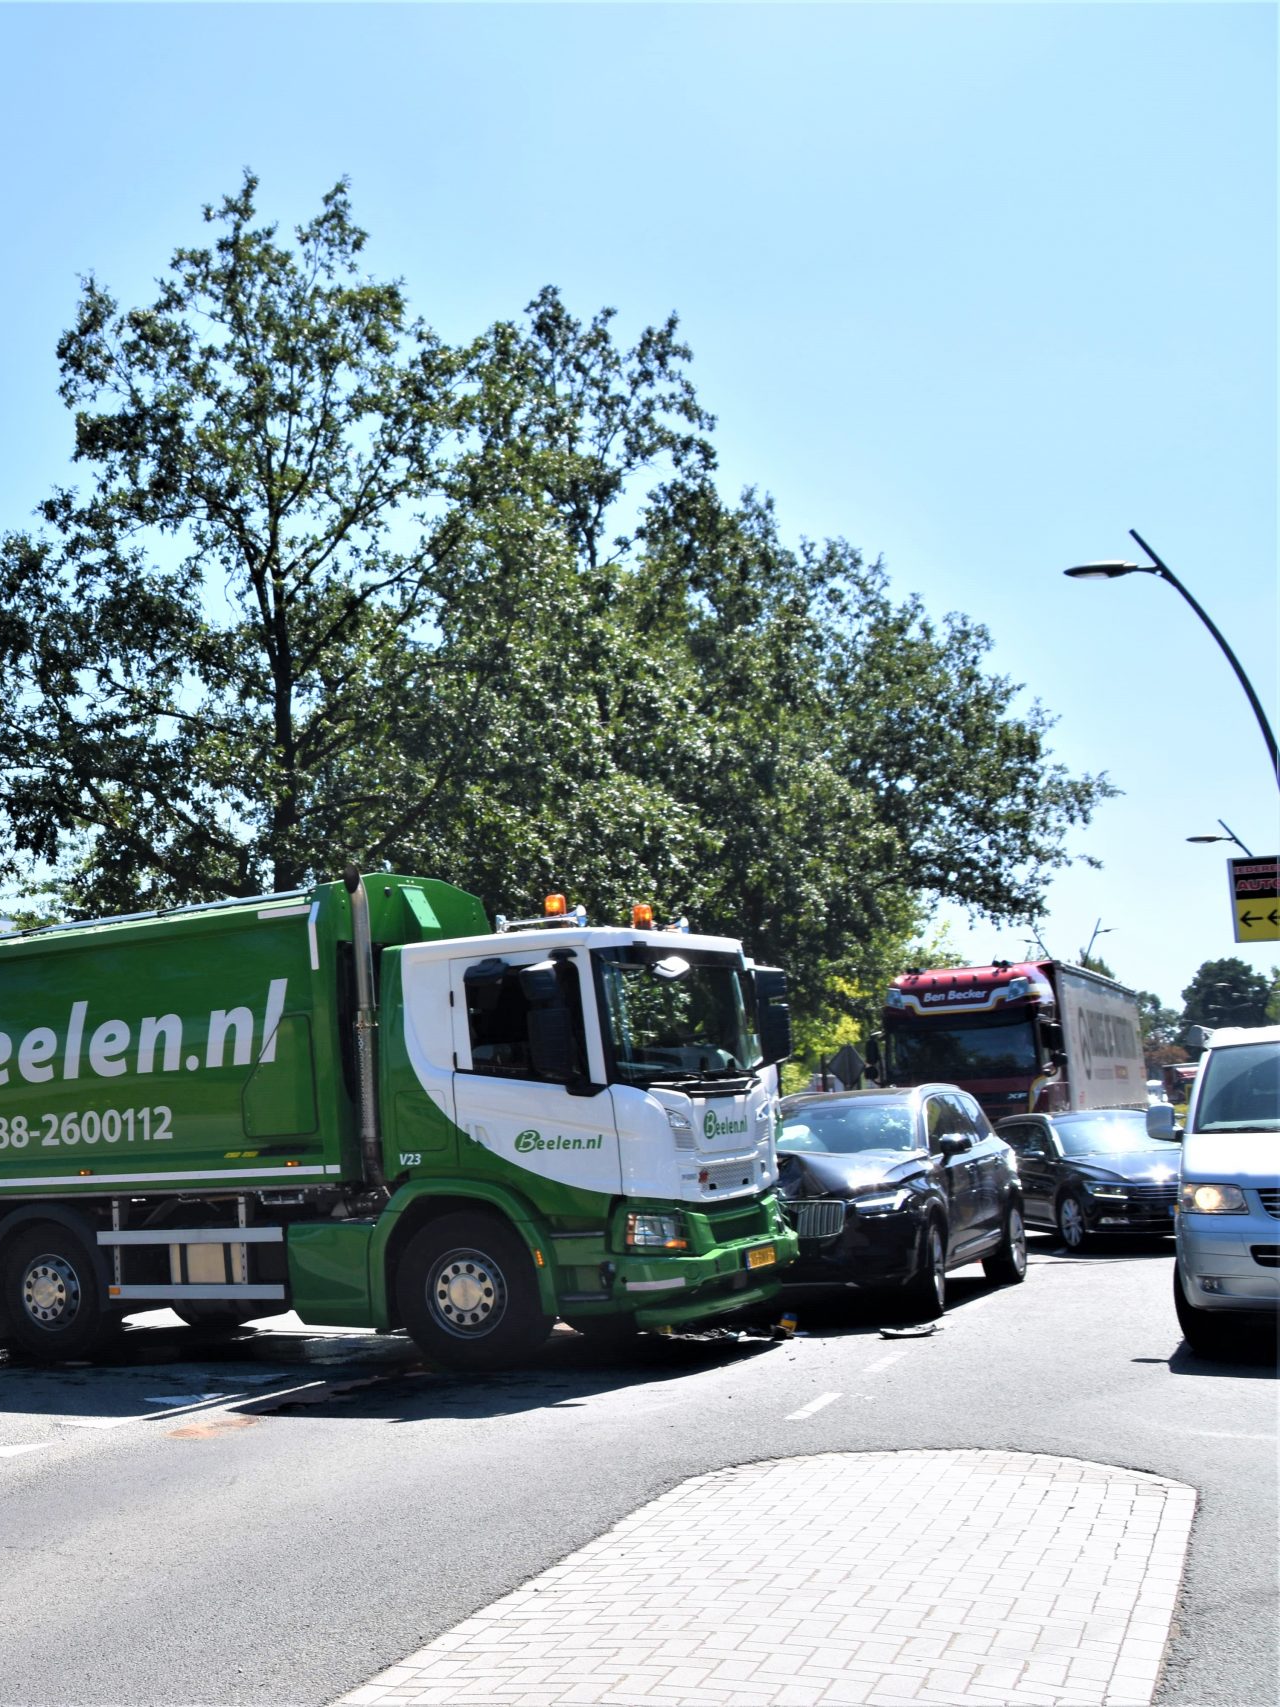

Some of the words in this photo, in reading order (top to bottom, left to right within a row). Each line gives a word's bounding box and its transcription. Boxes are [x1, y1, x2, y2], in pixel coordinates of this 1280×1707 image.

[924, 993, 945, 1002] Ben
[948, 989, 987, 1000] Becker
[703, 1110, 748, 1139] Beelen.nl
[515, 1129, 602, 1153] Beelen.nl
[399, 1153, 421, 1166] V23
